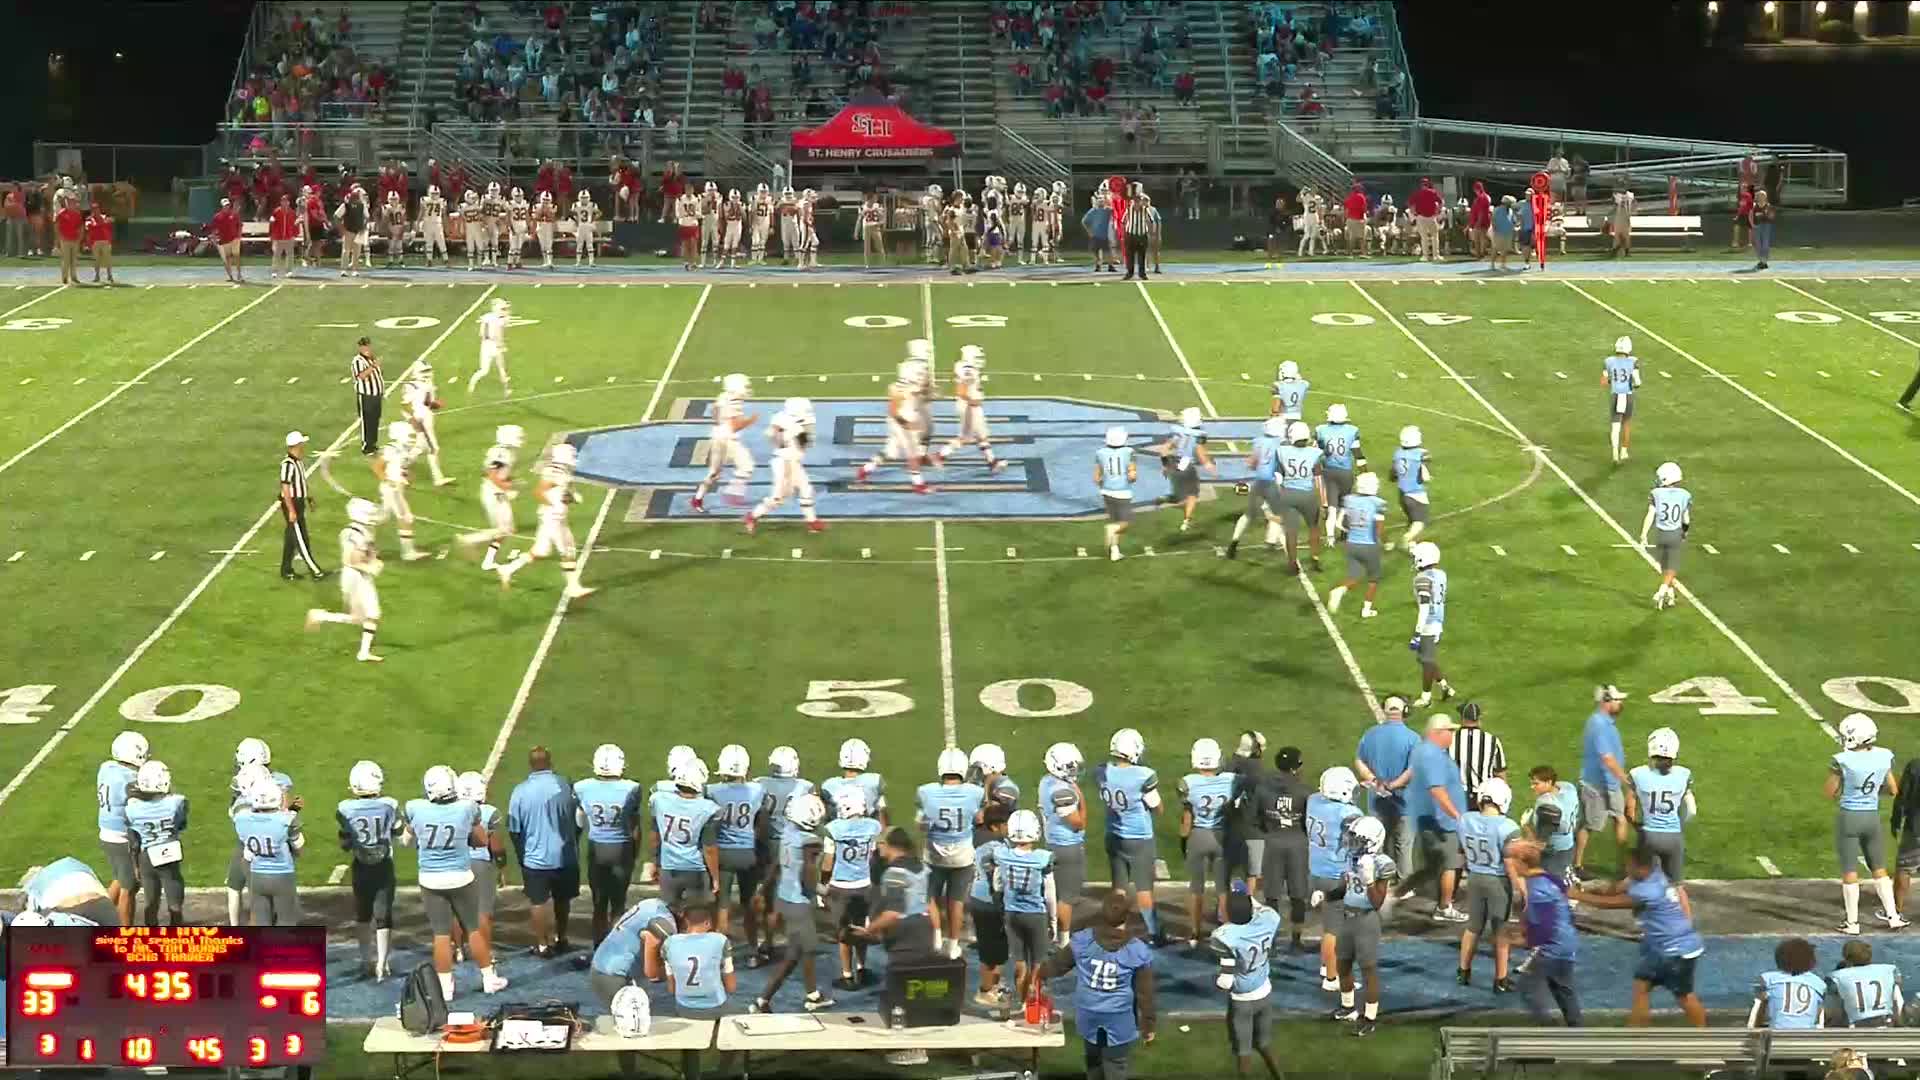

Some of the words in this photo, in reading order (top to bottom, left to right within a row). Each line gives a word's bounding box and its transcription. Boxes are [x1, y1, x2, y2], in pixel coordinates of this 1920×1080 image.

[808, 148, 824, 158] ST.
[825, 149, 862, 158] HENRY
[1613, 368, 1628, 383] 13
[1290, 391, 1299, 408] 9
[1325, 437, 1346, 457] 68
[1287, 458, 1308, 478] 56
[1660, 502, 1681, 523] 30
[1648, 790, 1674, 815] 15
[355, 815, 384, 846] 31
[425, 823, 456, 851] 72
[663, 814, 691, 845] 75
[1465, 836, 1494, 866] 55
[686, 956, 700, 987] 2
[1781, 981, 1812, 1014] 19
[1854, 980, 1884, 1013] 12
